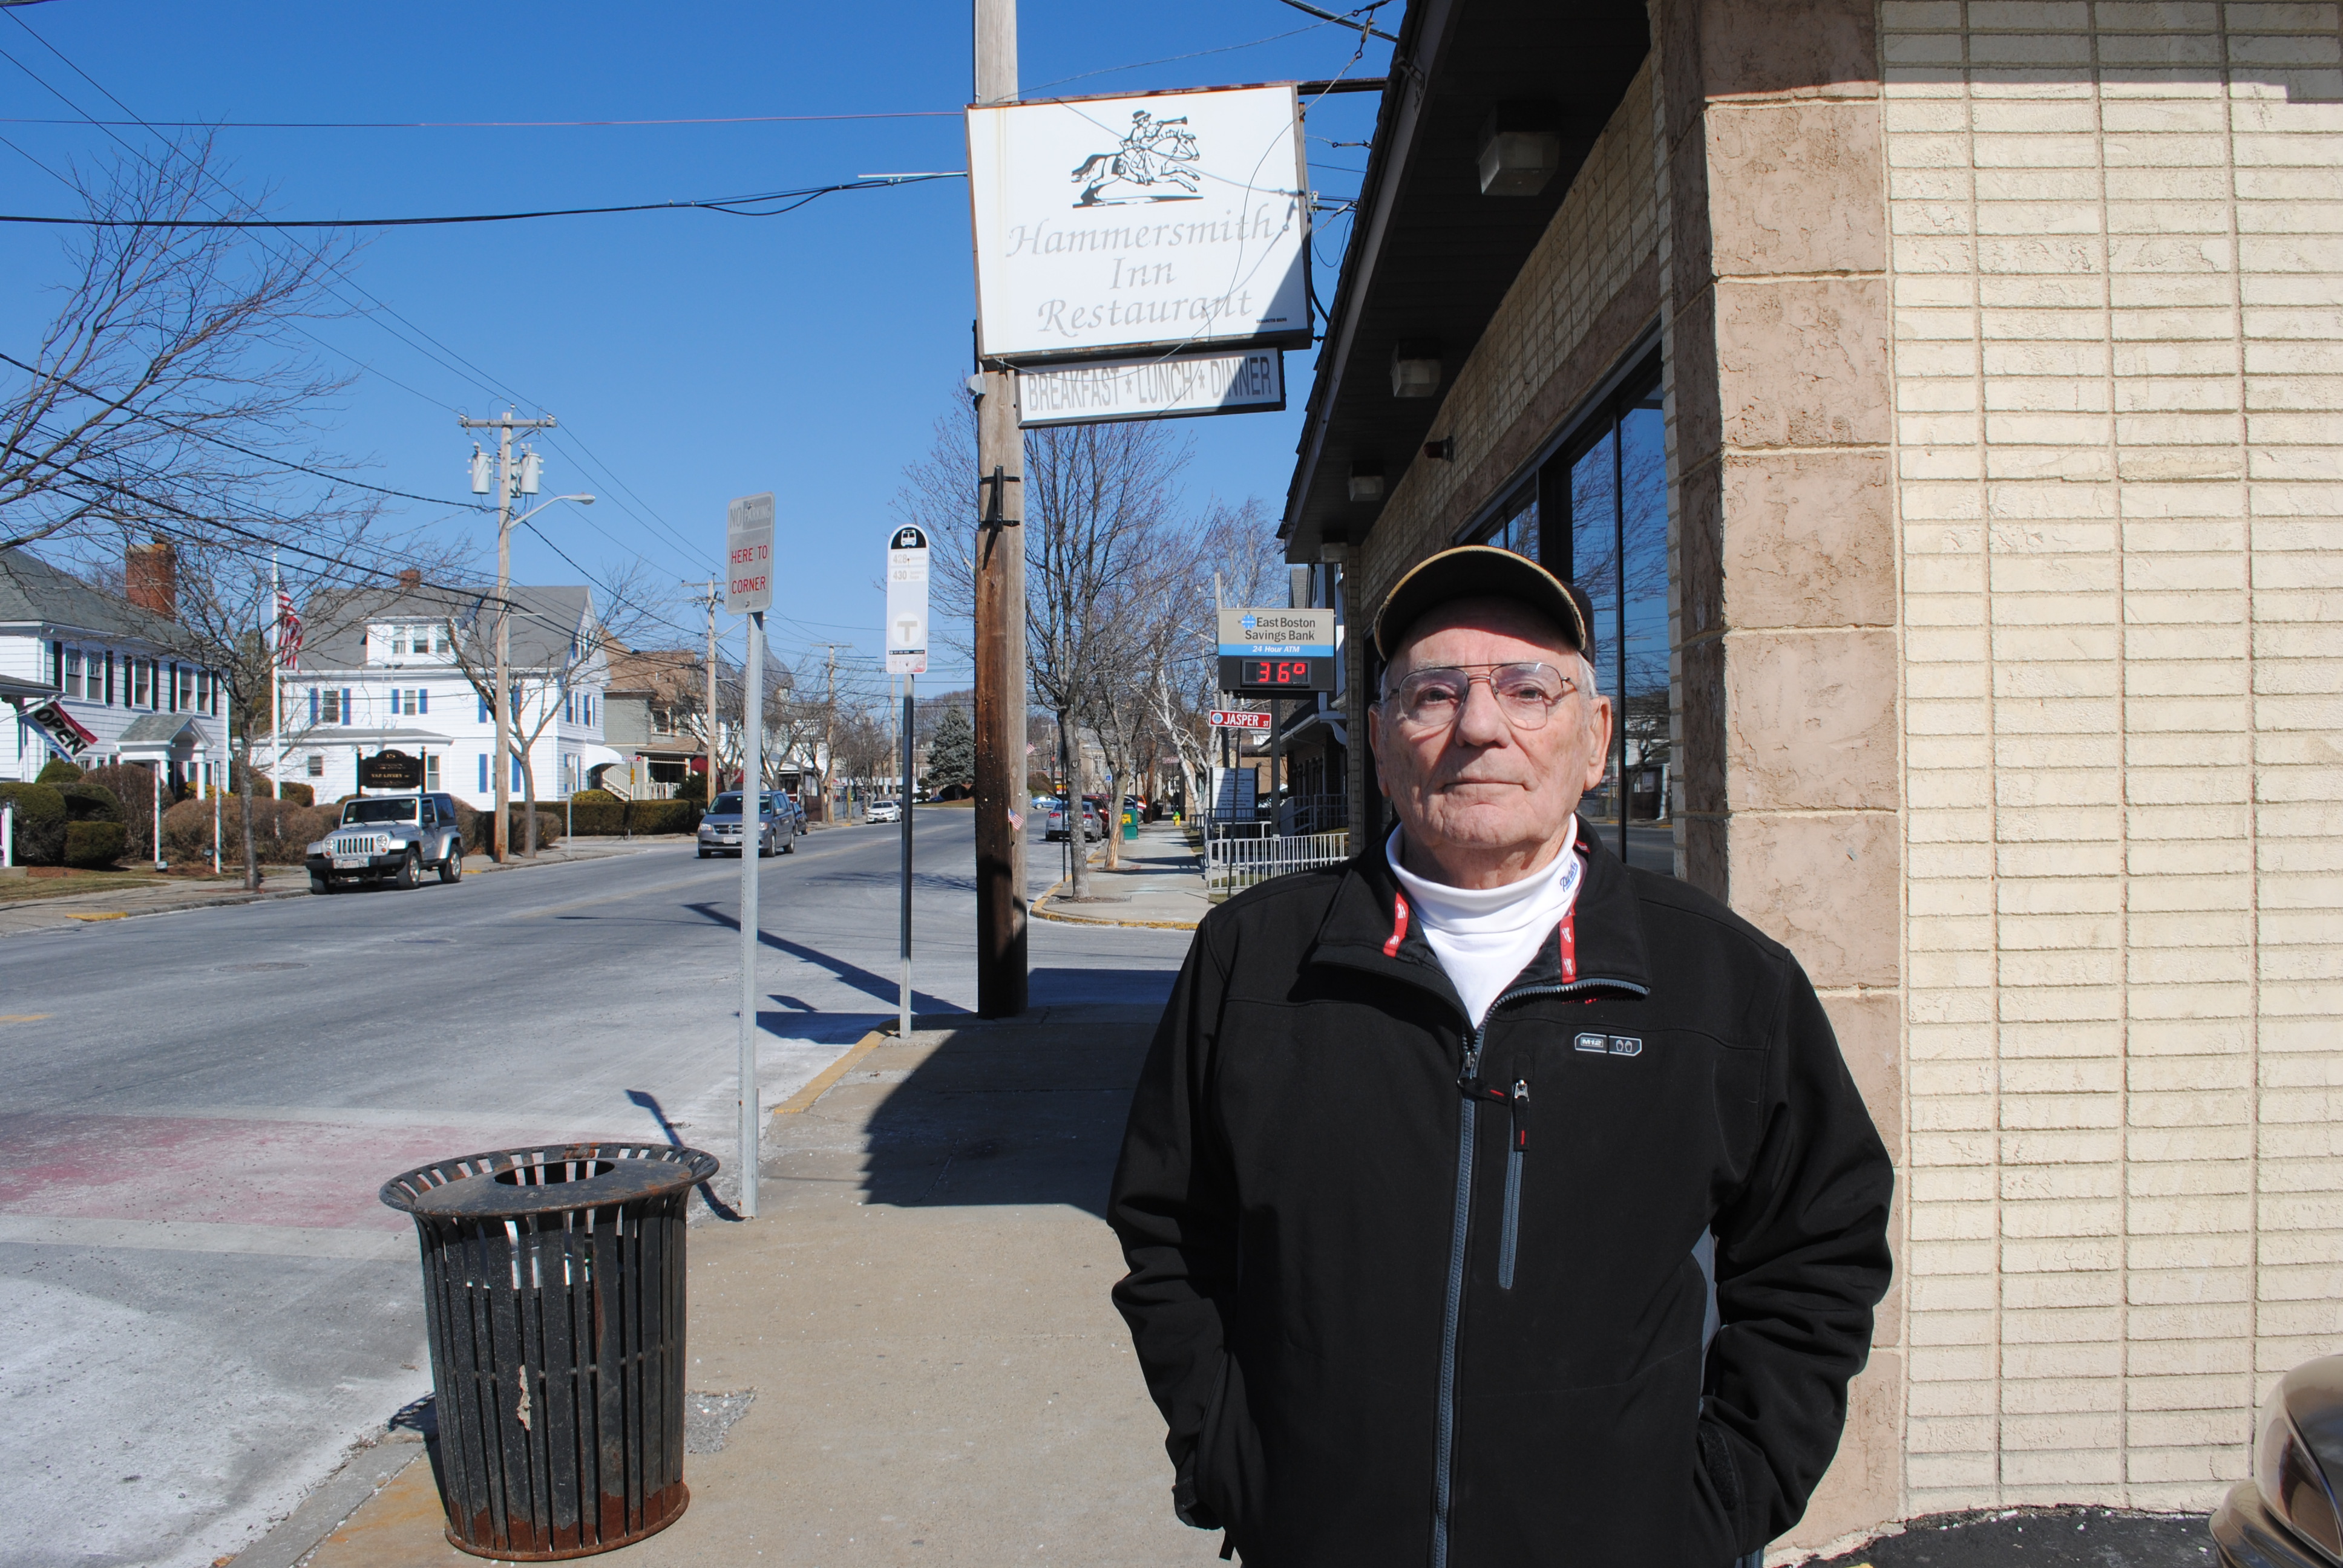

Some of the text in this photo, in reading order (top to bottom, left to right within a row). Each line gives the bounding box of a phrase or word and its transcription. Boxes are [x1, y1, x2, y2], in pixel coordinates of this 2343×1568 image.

[1005, 203, 1274, 258] Hammersmith
[1109, 257, 1177, 290] Inn
[1037, 290, 1253, 338] Restaurant
[1029, 356, 1272, 411] BREAKFAST LUNCH DINNER
[729, 504, 770, 529] NO PARKING
[731, 545, 768, 564] HERE TO
[893, 554, 907, 563] 428
[732, 576, 765, 594] CORNER
[893, 570, 907, 580] 430
[897, 621, 917, 642] T
[1256, 617, 1316, 628] East Boston
[1245, 630, 1315, 642] Savings Bank
[1224, 713, 1259, 727] JASPER
[34, 709, 88, 756] OPEN
